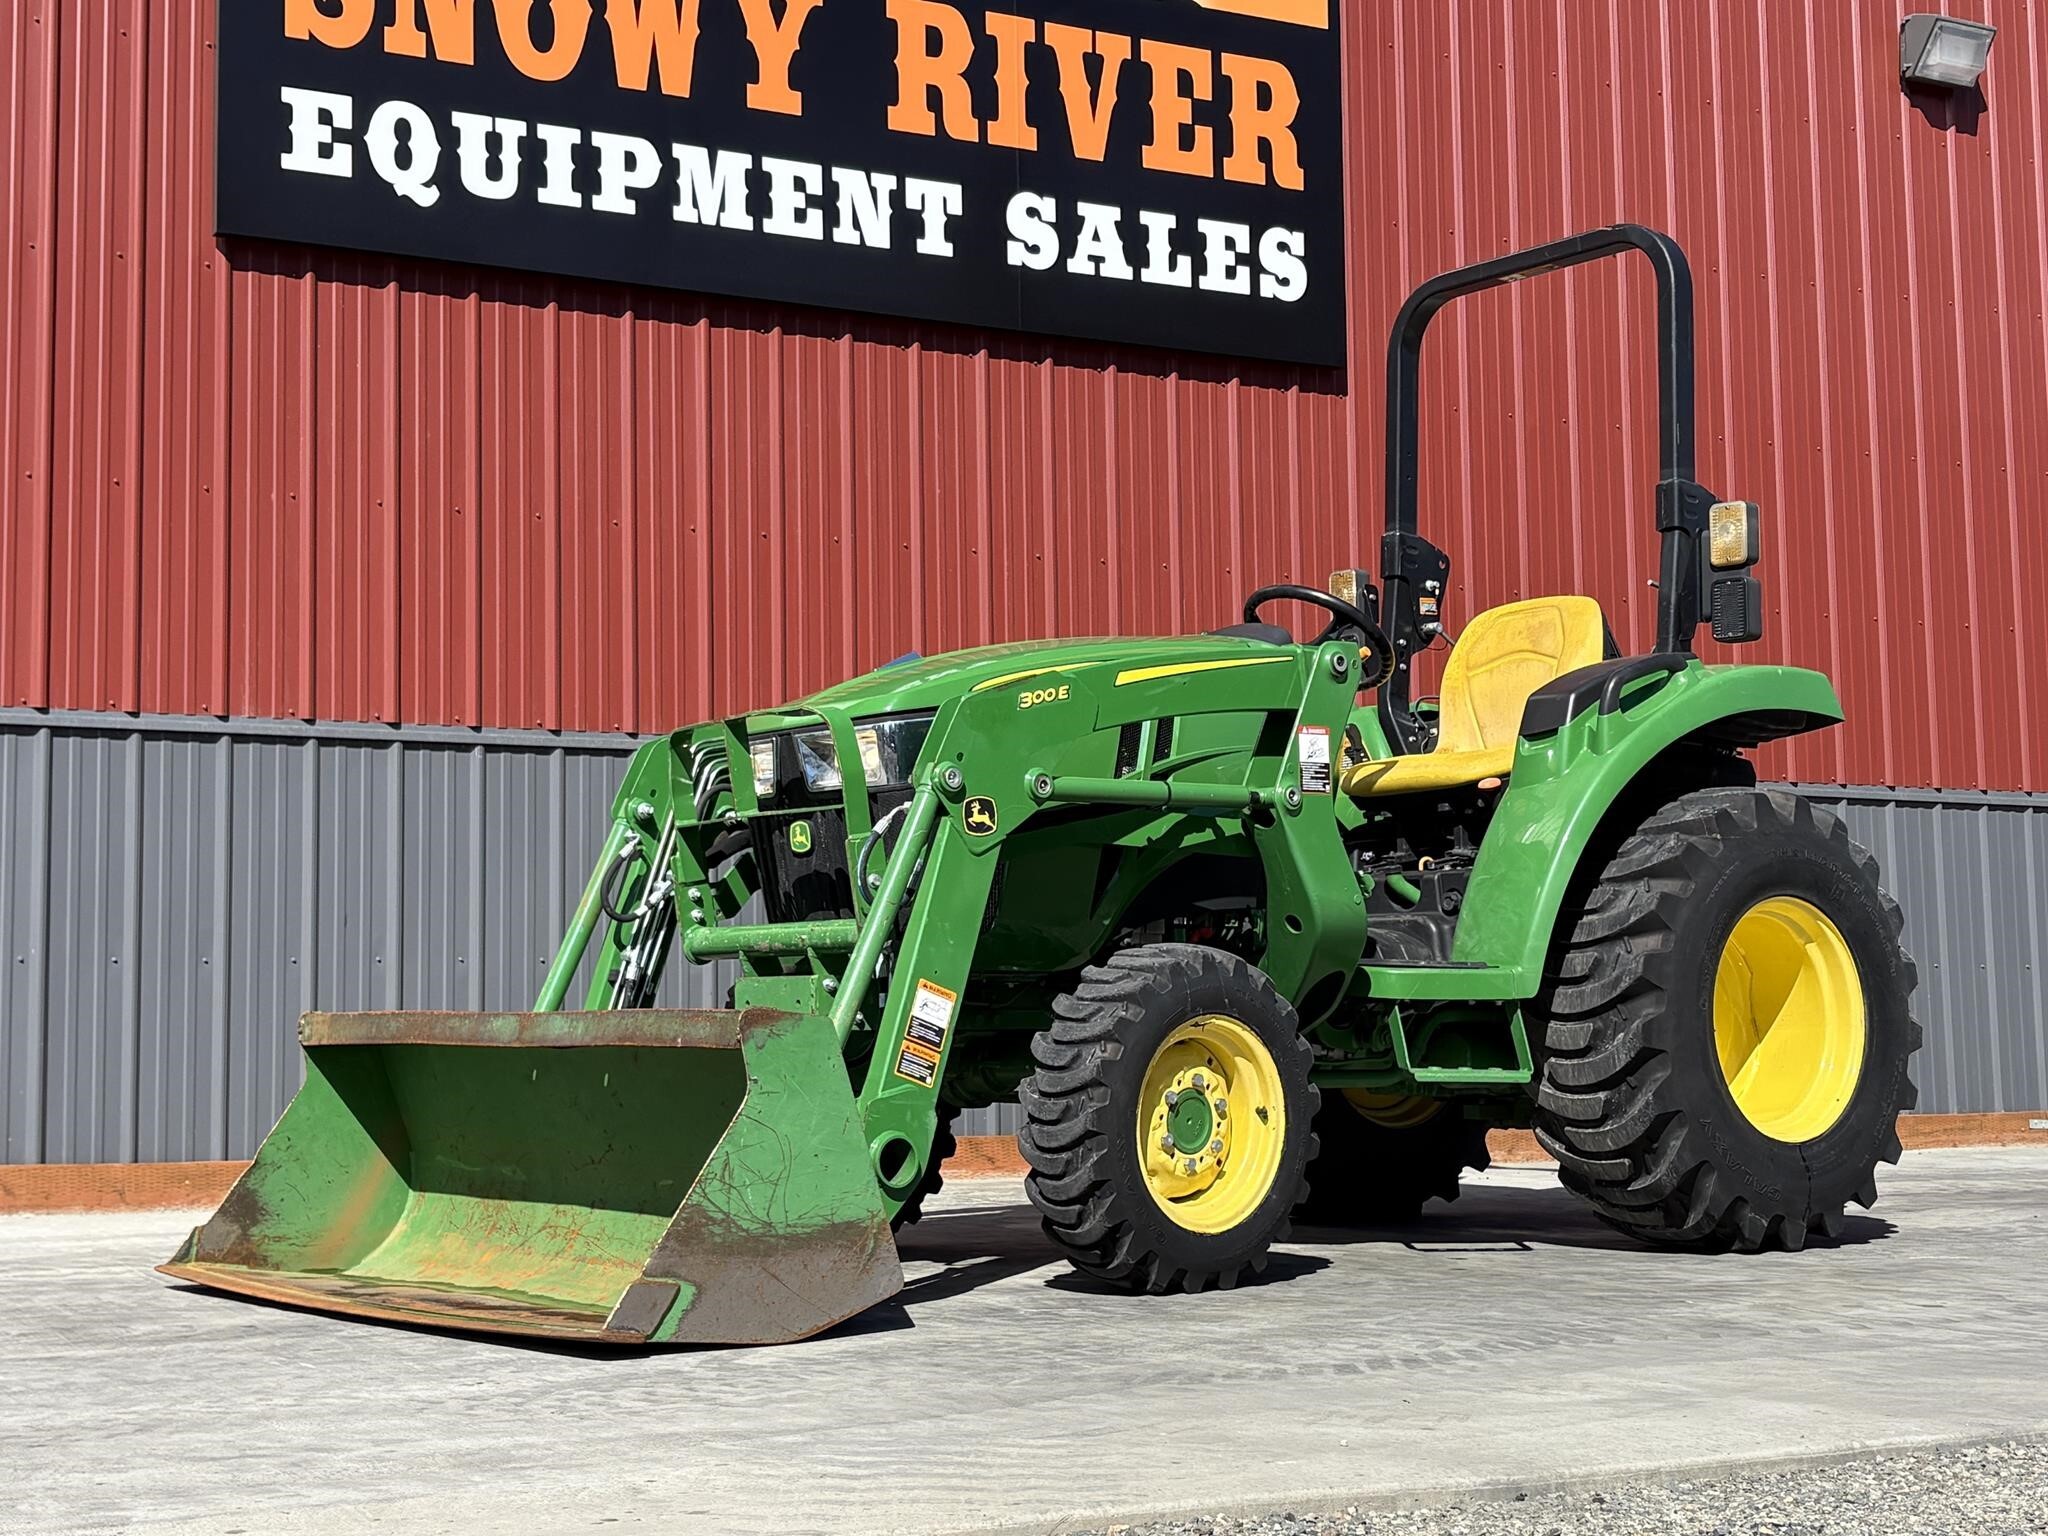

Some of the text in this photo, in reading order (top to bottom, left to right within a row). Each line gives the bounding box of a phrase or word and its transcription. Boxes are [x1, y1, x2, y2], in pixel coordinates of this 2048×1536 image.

[886, 0, 1304, 191] RIVER
[280, 86, 1308, 302] EQUIPMENT SALES
[1018, 684, 1070, 709] 300 E
